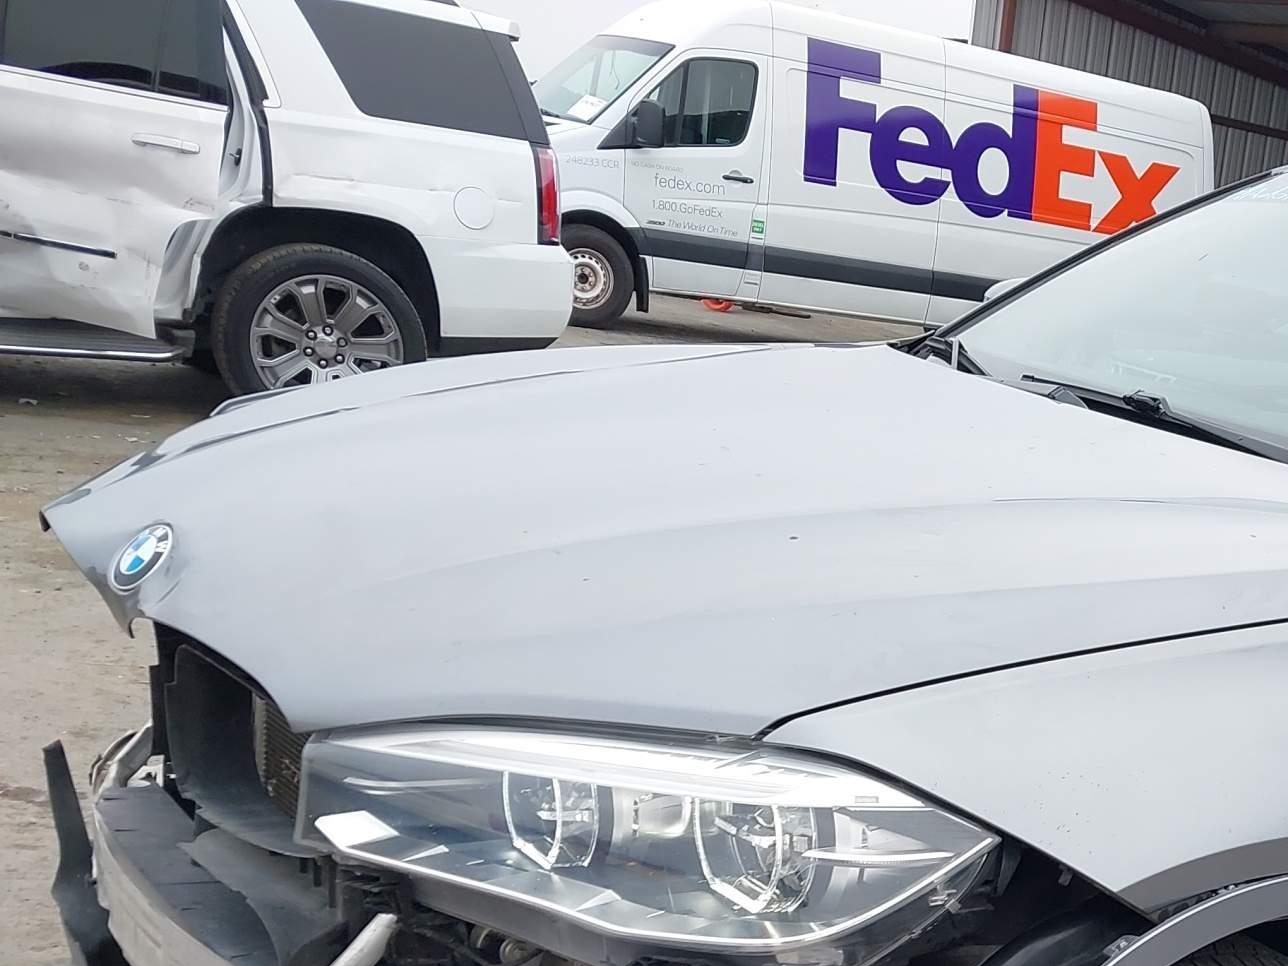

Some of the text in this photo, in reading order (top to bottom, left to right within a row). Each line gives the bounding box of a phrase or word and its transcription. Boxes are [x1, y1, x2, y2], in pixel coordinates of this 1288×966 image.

[803, 36, 1181, 235] FedEx
[654, 173, 726, 196] fedex.com
[667, 219, 682, 228] The
[683, 221, 706, 232] World
[719, 225, 738, 237] Time
